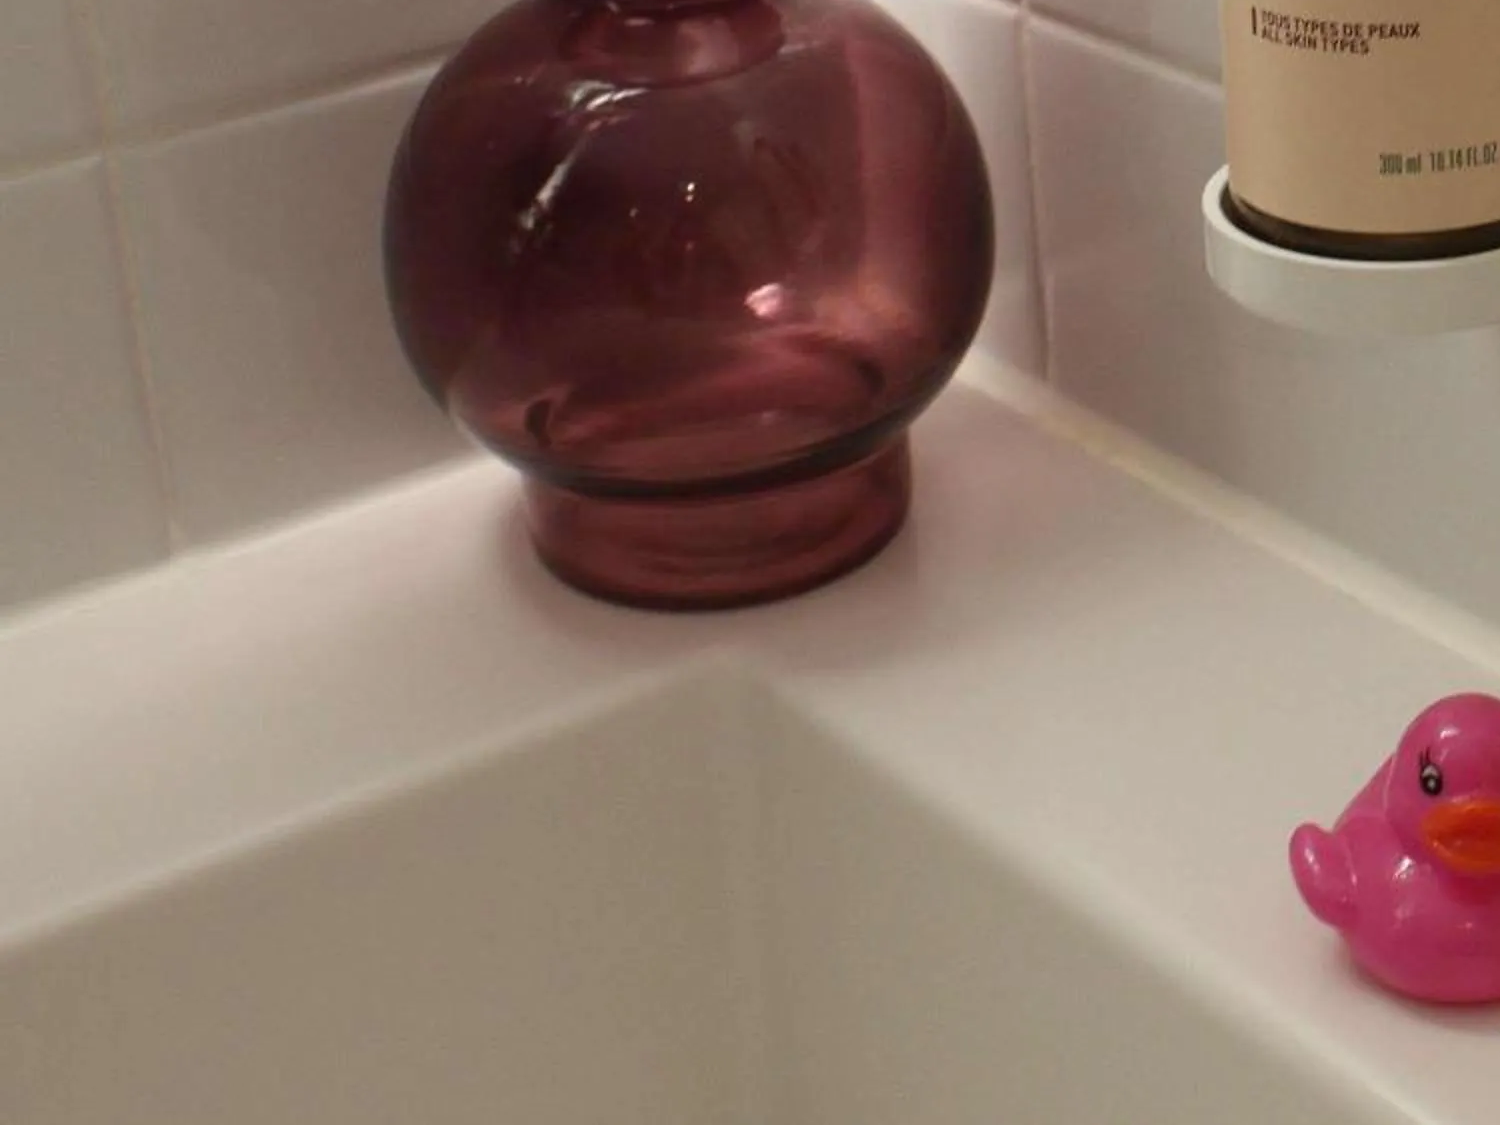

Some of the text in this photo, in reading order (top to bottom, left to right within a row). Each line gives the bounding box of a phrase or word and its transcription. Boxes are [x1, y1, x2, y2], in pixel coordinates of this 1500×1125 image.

[1294, 17, 1340, 38] TYPES
[1342, 22, 1365, 38] DE
[1367, 22, 1422, 41] PEAUX
[1284, 31, 1318, 53] SKIN
[1321, 36, 1371, 56] TYPES
